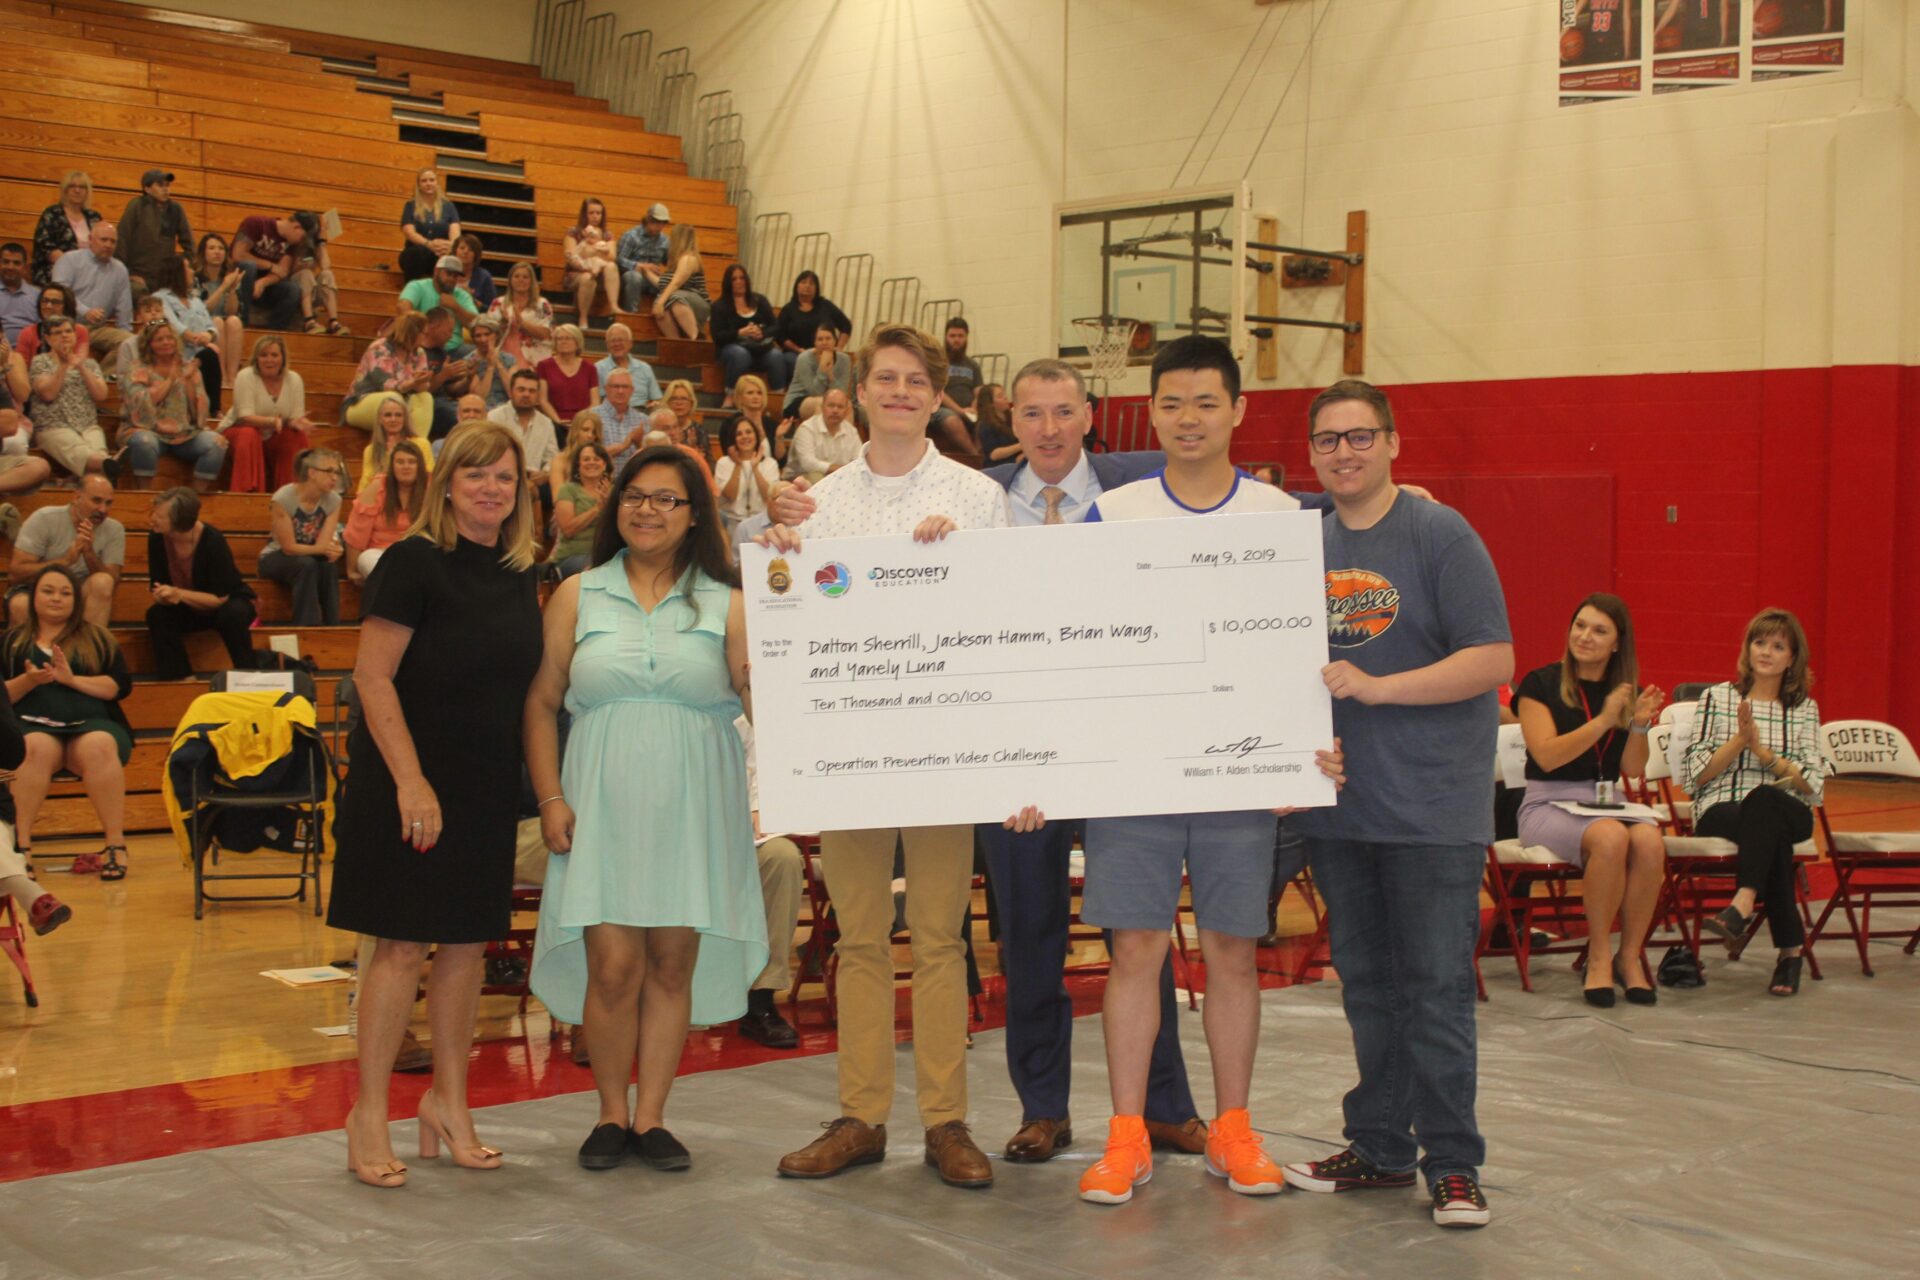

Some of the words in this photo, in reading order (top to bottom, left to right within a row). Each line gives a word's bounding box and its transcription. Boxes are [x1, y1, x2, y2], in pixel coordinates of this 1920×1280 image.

[1191, 553, 1218, 567] May
[1222, 551, 1237, 564] 9,
[1242, 549, 1276, 561] 2019
[874, 566, 950, 580] Discovery
[874, 579, 940, 588] EDUCATION
[1325, 586, 1400, 616] nessee
[1222, 616, 1313, 634] 10,000.00
[808, 638, 858, 656] Dalton
[864, 633, 927, 653] Sherrill,
[928, 631, 993, 654] Jackson
[998, 629, 1052, 645] Hamm,
[1059, 625, 1104, 642] Brian
[1110, 624, 1159, 644] Wang,
[809, 662, 840, 679] and
[906, 660, 946, 674] Luna
[810, 698, 837, 711] Ten
[839, 692, 903, 710] Thousand
[908, 691, 933, 706] and
[1827, 727, 1899, 749] COFFEE
[815, 757, 878, 776] Operation
[883, 754, 950, 769] Prevention
[954, 752, 989, 765] Video
[993, 748, 1059, 766] Challenge
[1834, 750, 1899, 762] COUNTY
[1183, 766, 1214, 777] William
[1216, 766, 1224, 776] F.
[1225, 765, 1250, 776] Alden
[1253, 763, 1303, 775] Scholarship
